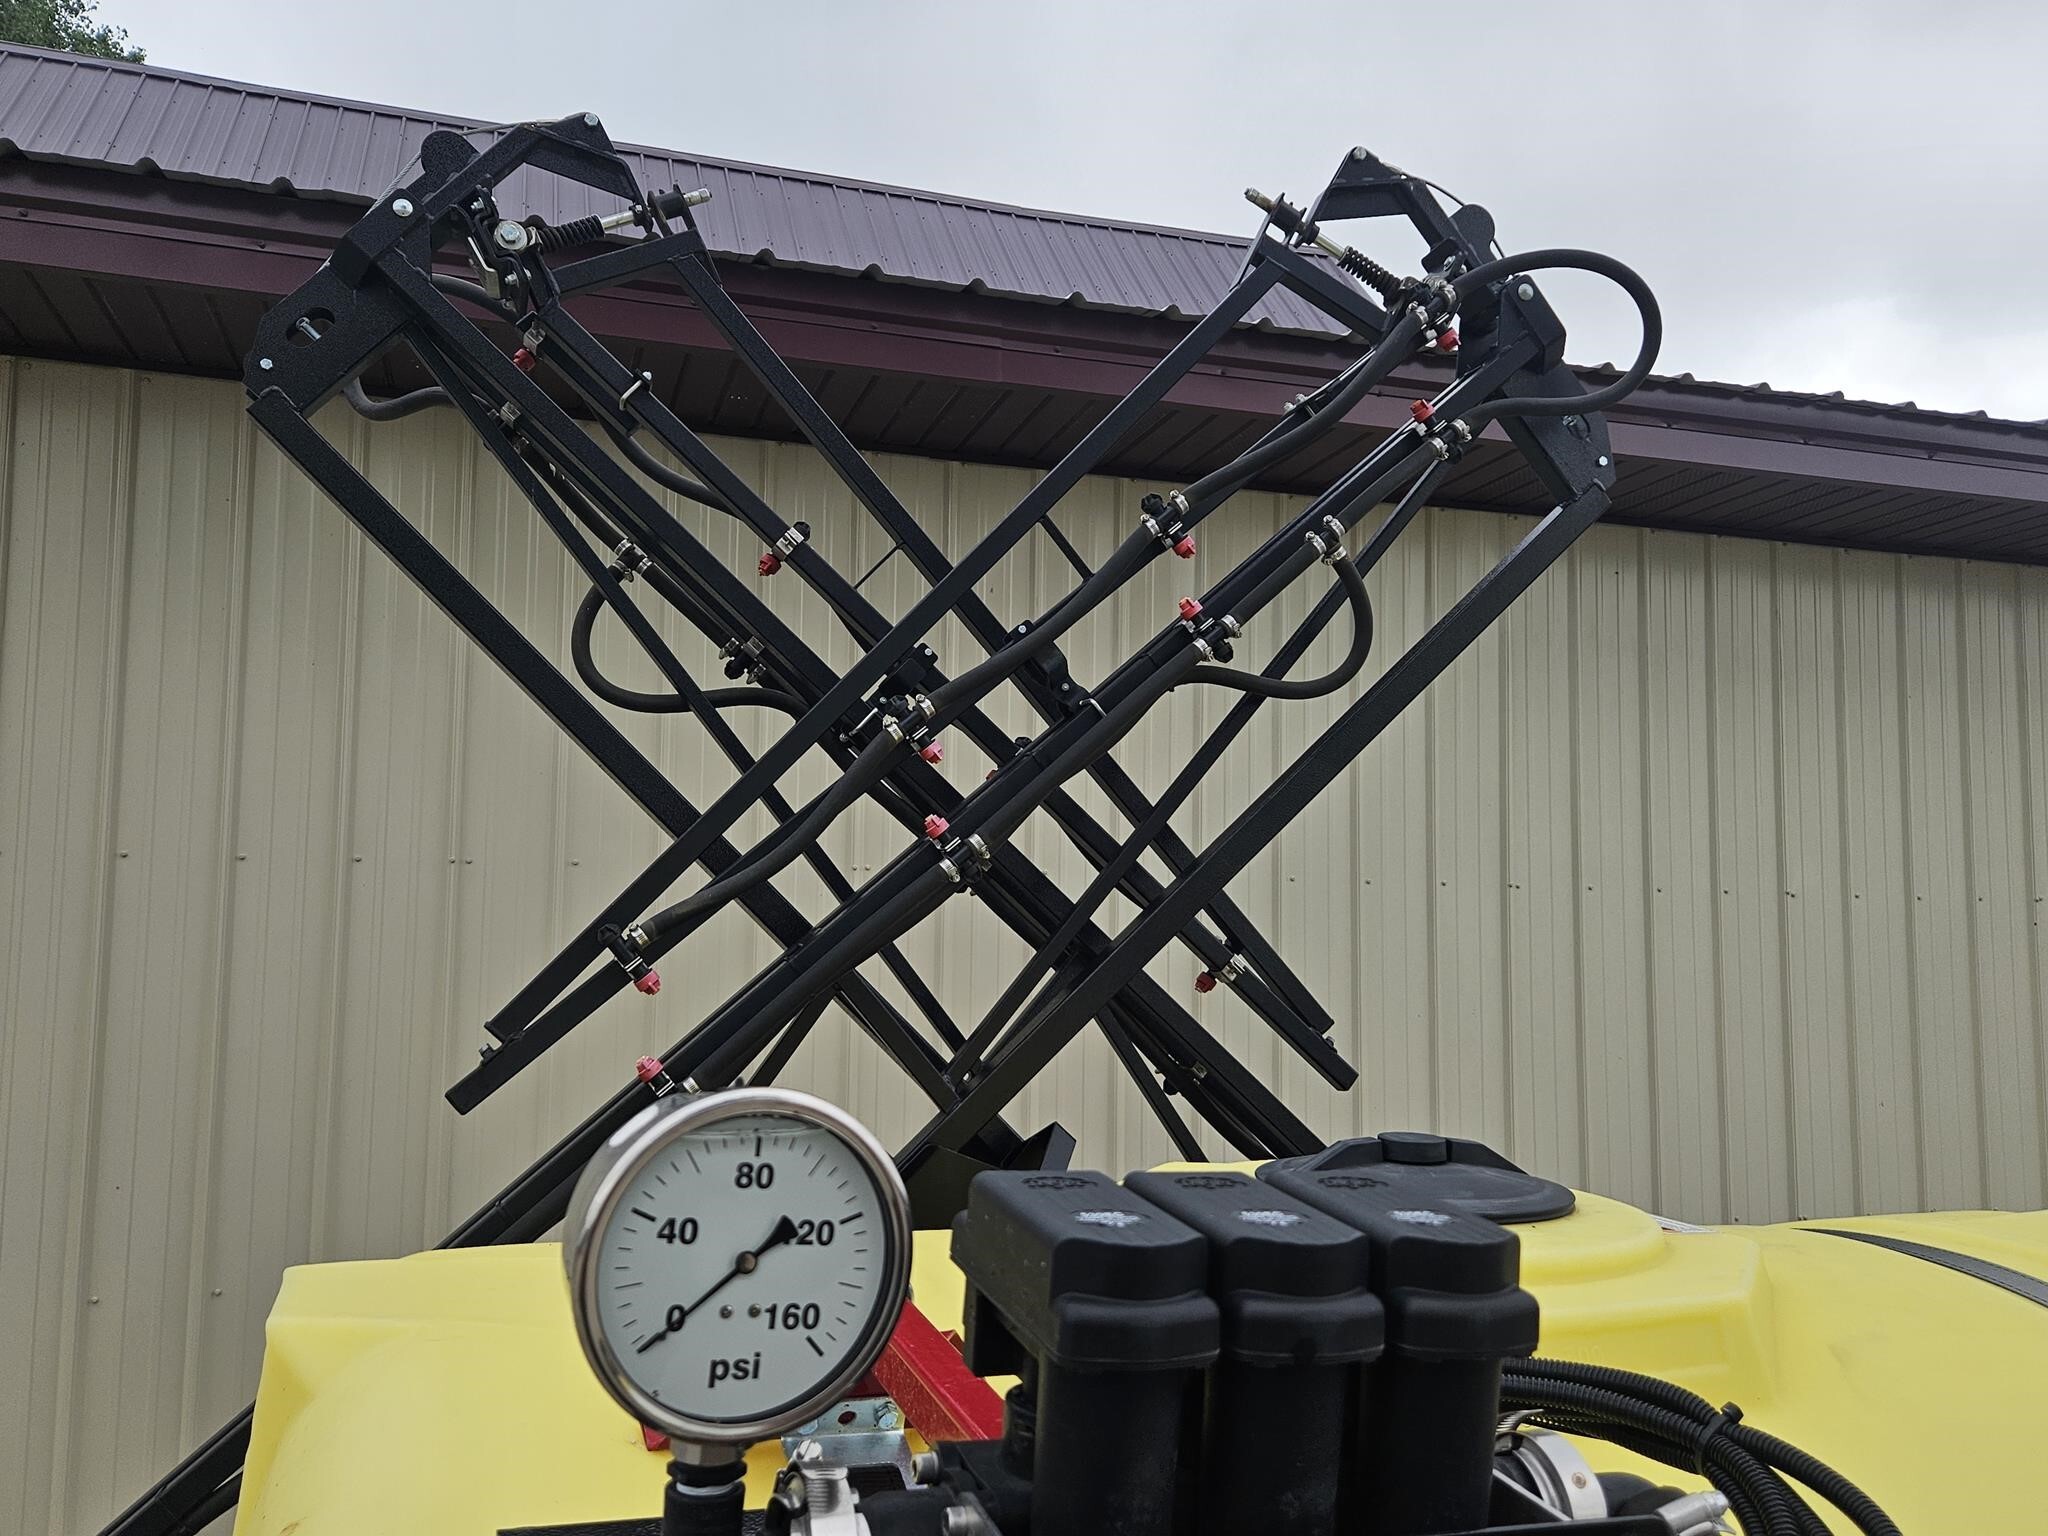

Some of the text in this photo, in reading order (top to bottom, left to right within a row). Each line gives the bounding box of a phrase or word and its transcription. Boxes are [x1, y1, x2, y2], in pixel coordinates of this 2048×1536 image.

[735, 1162, 774, 1189] 80
[656, 1217, 699, 1245] 40
[784, 1219, 834, 1246] 20
[666, 1304, 686, 1332] 0
[764, 1302, 820, 1330] 160
[708, 1351, 761, 1388] psi
